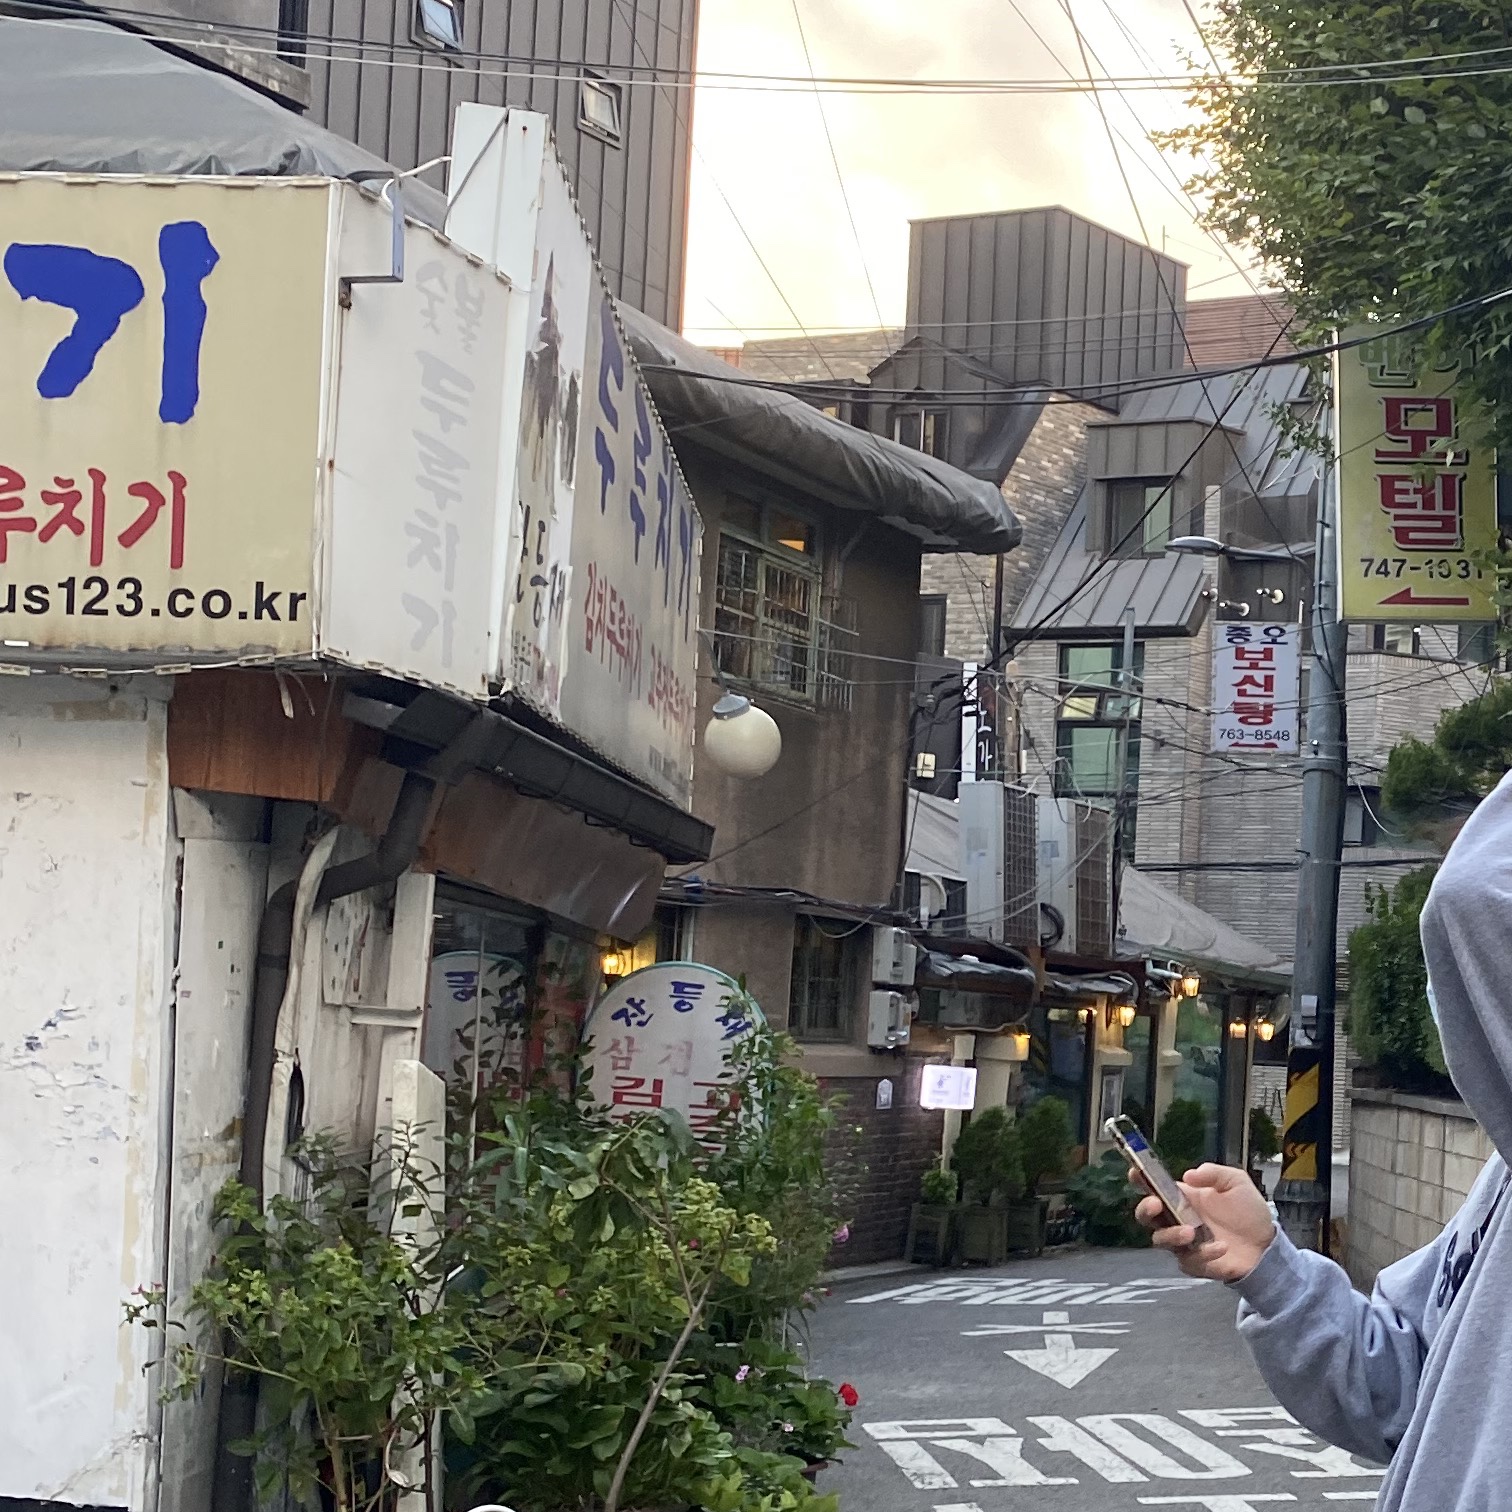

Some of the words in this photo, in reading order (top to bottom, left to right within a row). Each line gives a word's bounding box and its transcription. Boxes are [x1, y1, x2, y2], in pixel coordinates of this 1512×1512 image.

[1374, 397, 1469, 551] 모텔
[1231, 646, 1276, 726] 보신탕
[1218, 728, 1290, 741] 763-8548
